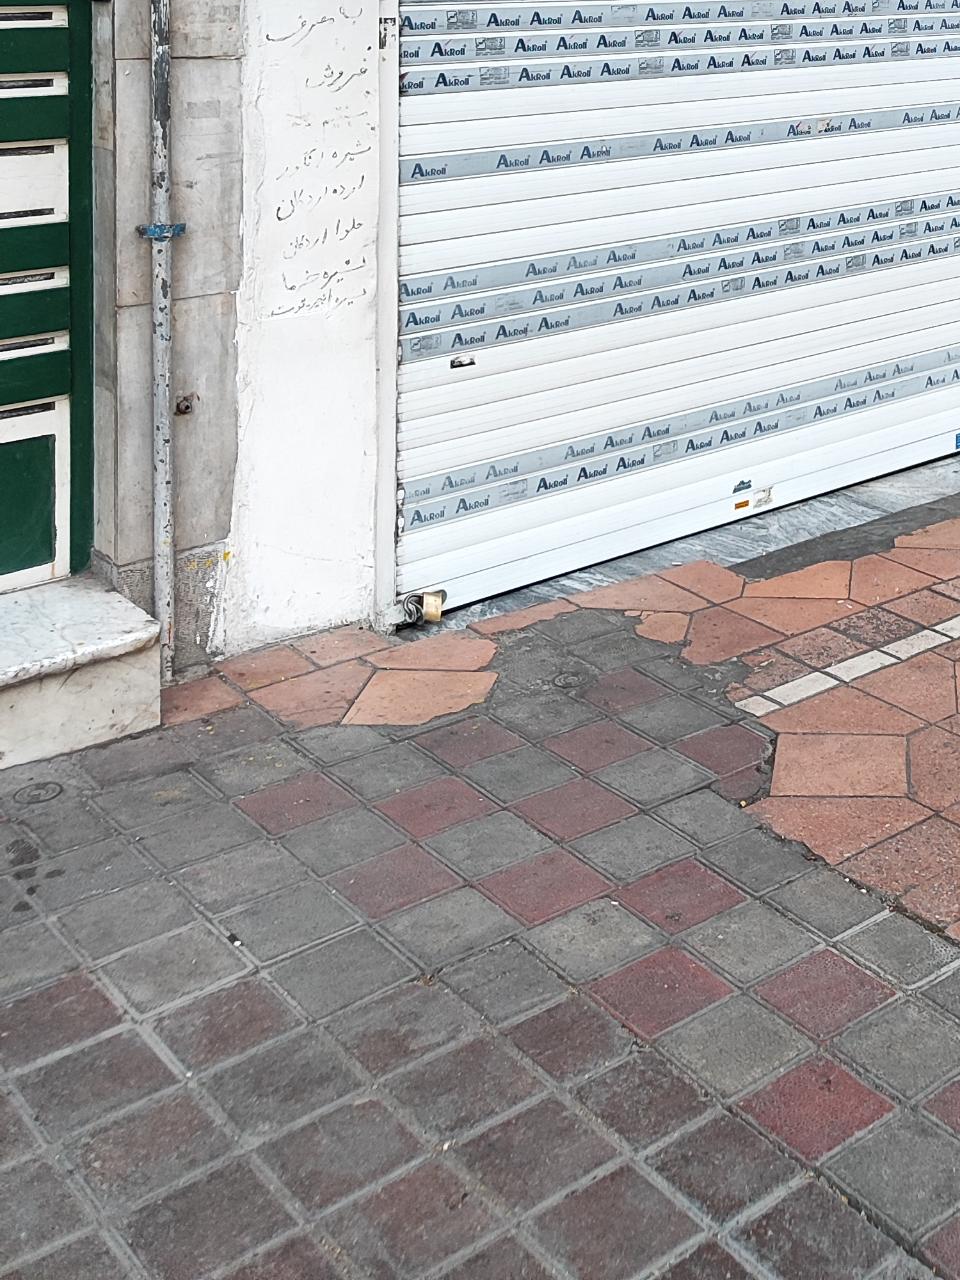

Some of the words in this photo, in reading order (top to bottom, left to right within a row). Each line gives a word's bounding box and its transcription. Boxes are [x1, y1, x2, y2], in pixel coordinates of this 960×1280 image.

[429, 41, 466, 57] AkRoll
[434, 71, 470, 87] AkRoll
[410, 162, 447, 178] AkRoll
[442, 274, 478, 291] AkRoll
[404, 310, 441, 328] AkRoll
[450, 303, 485, 320] AkRoll
[450, 331, 486, 349] AkRoll
[409, 508, 446, 526] AkRoll
[454, 496, 490, 514] AkRoll
